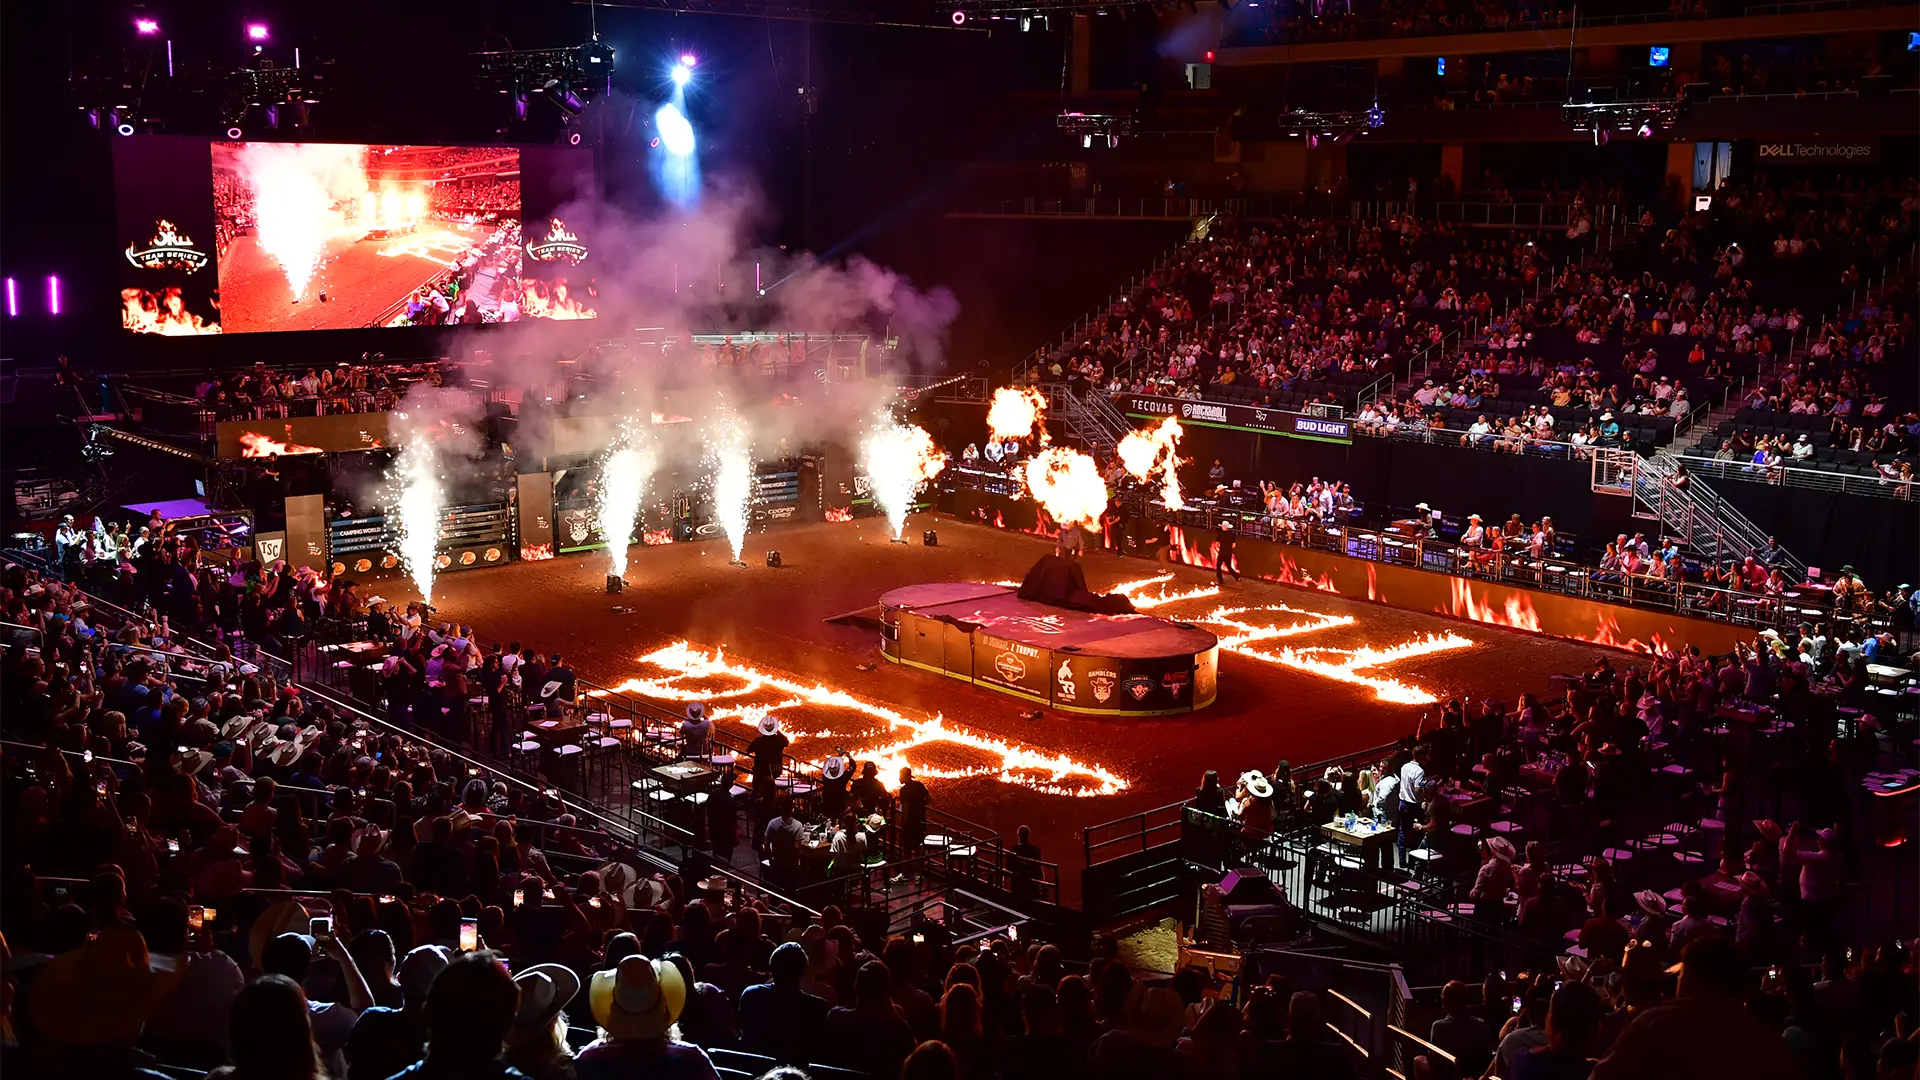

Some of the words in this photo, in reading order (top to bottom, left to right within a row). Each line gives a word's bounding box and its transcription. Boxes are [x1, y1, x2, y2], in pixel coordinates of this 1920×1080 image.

[1760, 144, 1794, 157] DELL
[1794, 143, 1871, 159] Technologies
[140, 252, 164, 261] TEAM
[166, 251, 199, 261] SERIES
[537, 246, 556, 255] TEAM
[556, 246, 581, 255] SERIES
[1131, 399, 1174, 414] TECOVAS
[1296, 420, 1318, 432] BUD
[1317, 422, 1346, 435] LIGHT
[856, 477, 869, 490] TSC
[339, 529, 364, 537] CAMPING
[363, 527, 381, 535] WORLD
[261, 541, 279, 558] TSC
[1088, 670, 1117, 679] GAMBLERS
